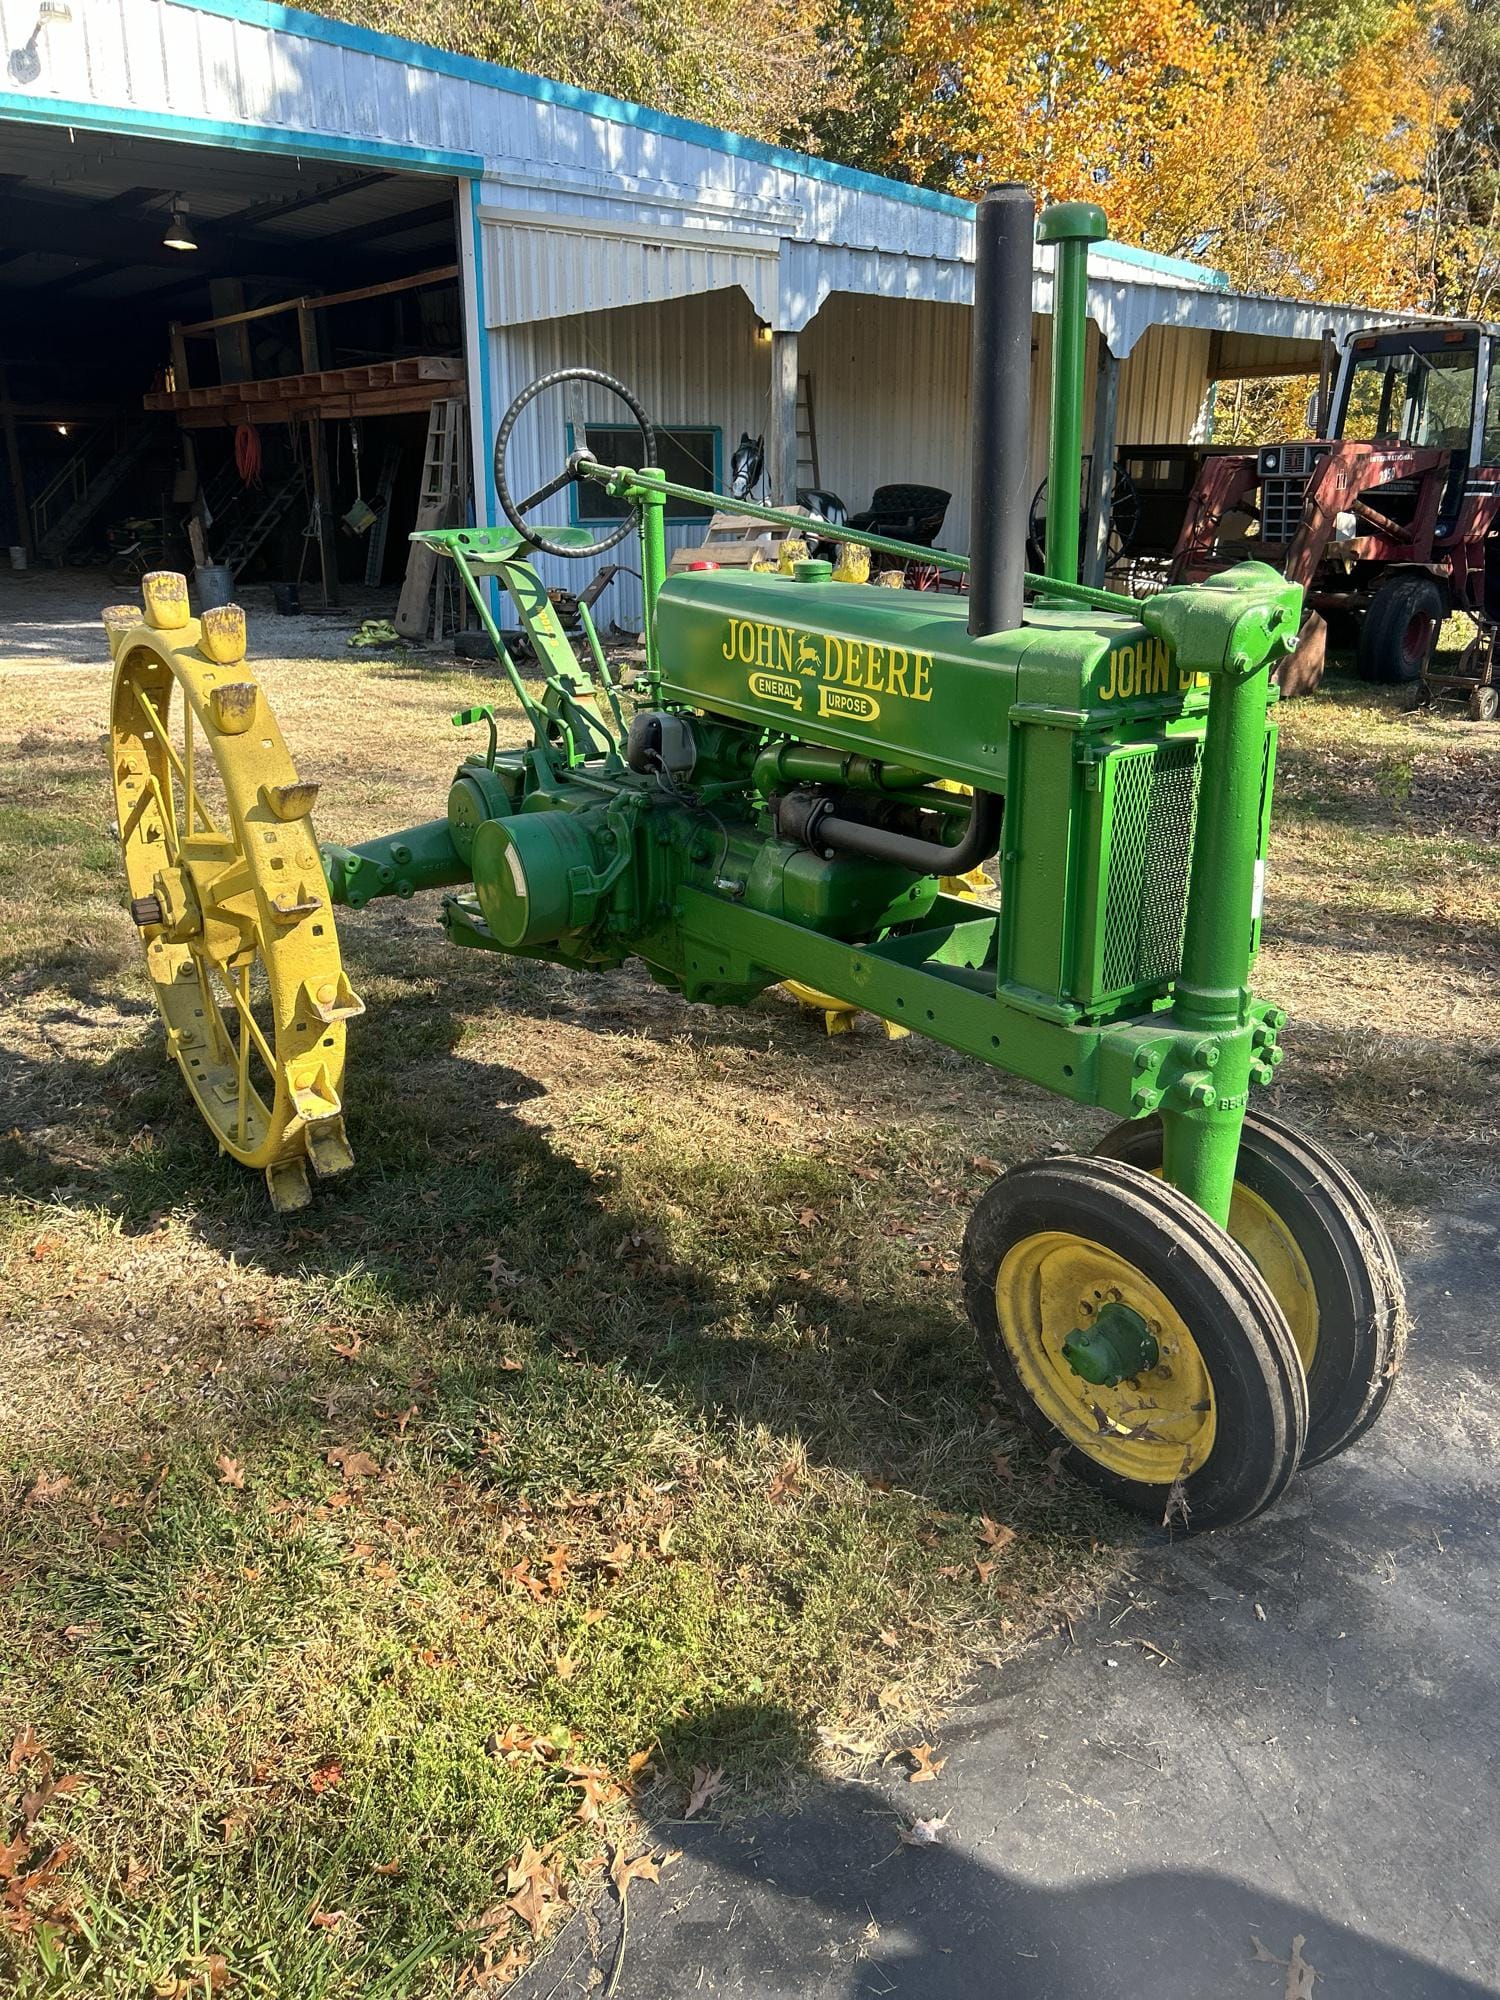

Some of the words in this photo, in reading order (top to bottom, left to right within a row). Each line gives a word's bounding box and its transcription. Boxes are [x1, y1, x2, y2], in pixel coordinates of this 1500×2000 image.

[722, 618, 796, 673] JOHN
[823, 634, 934, 702] DEERE
[1100, 638, 1170, 700] JOHN
